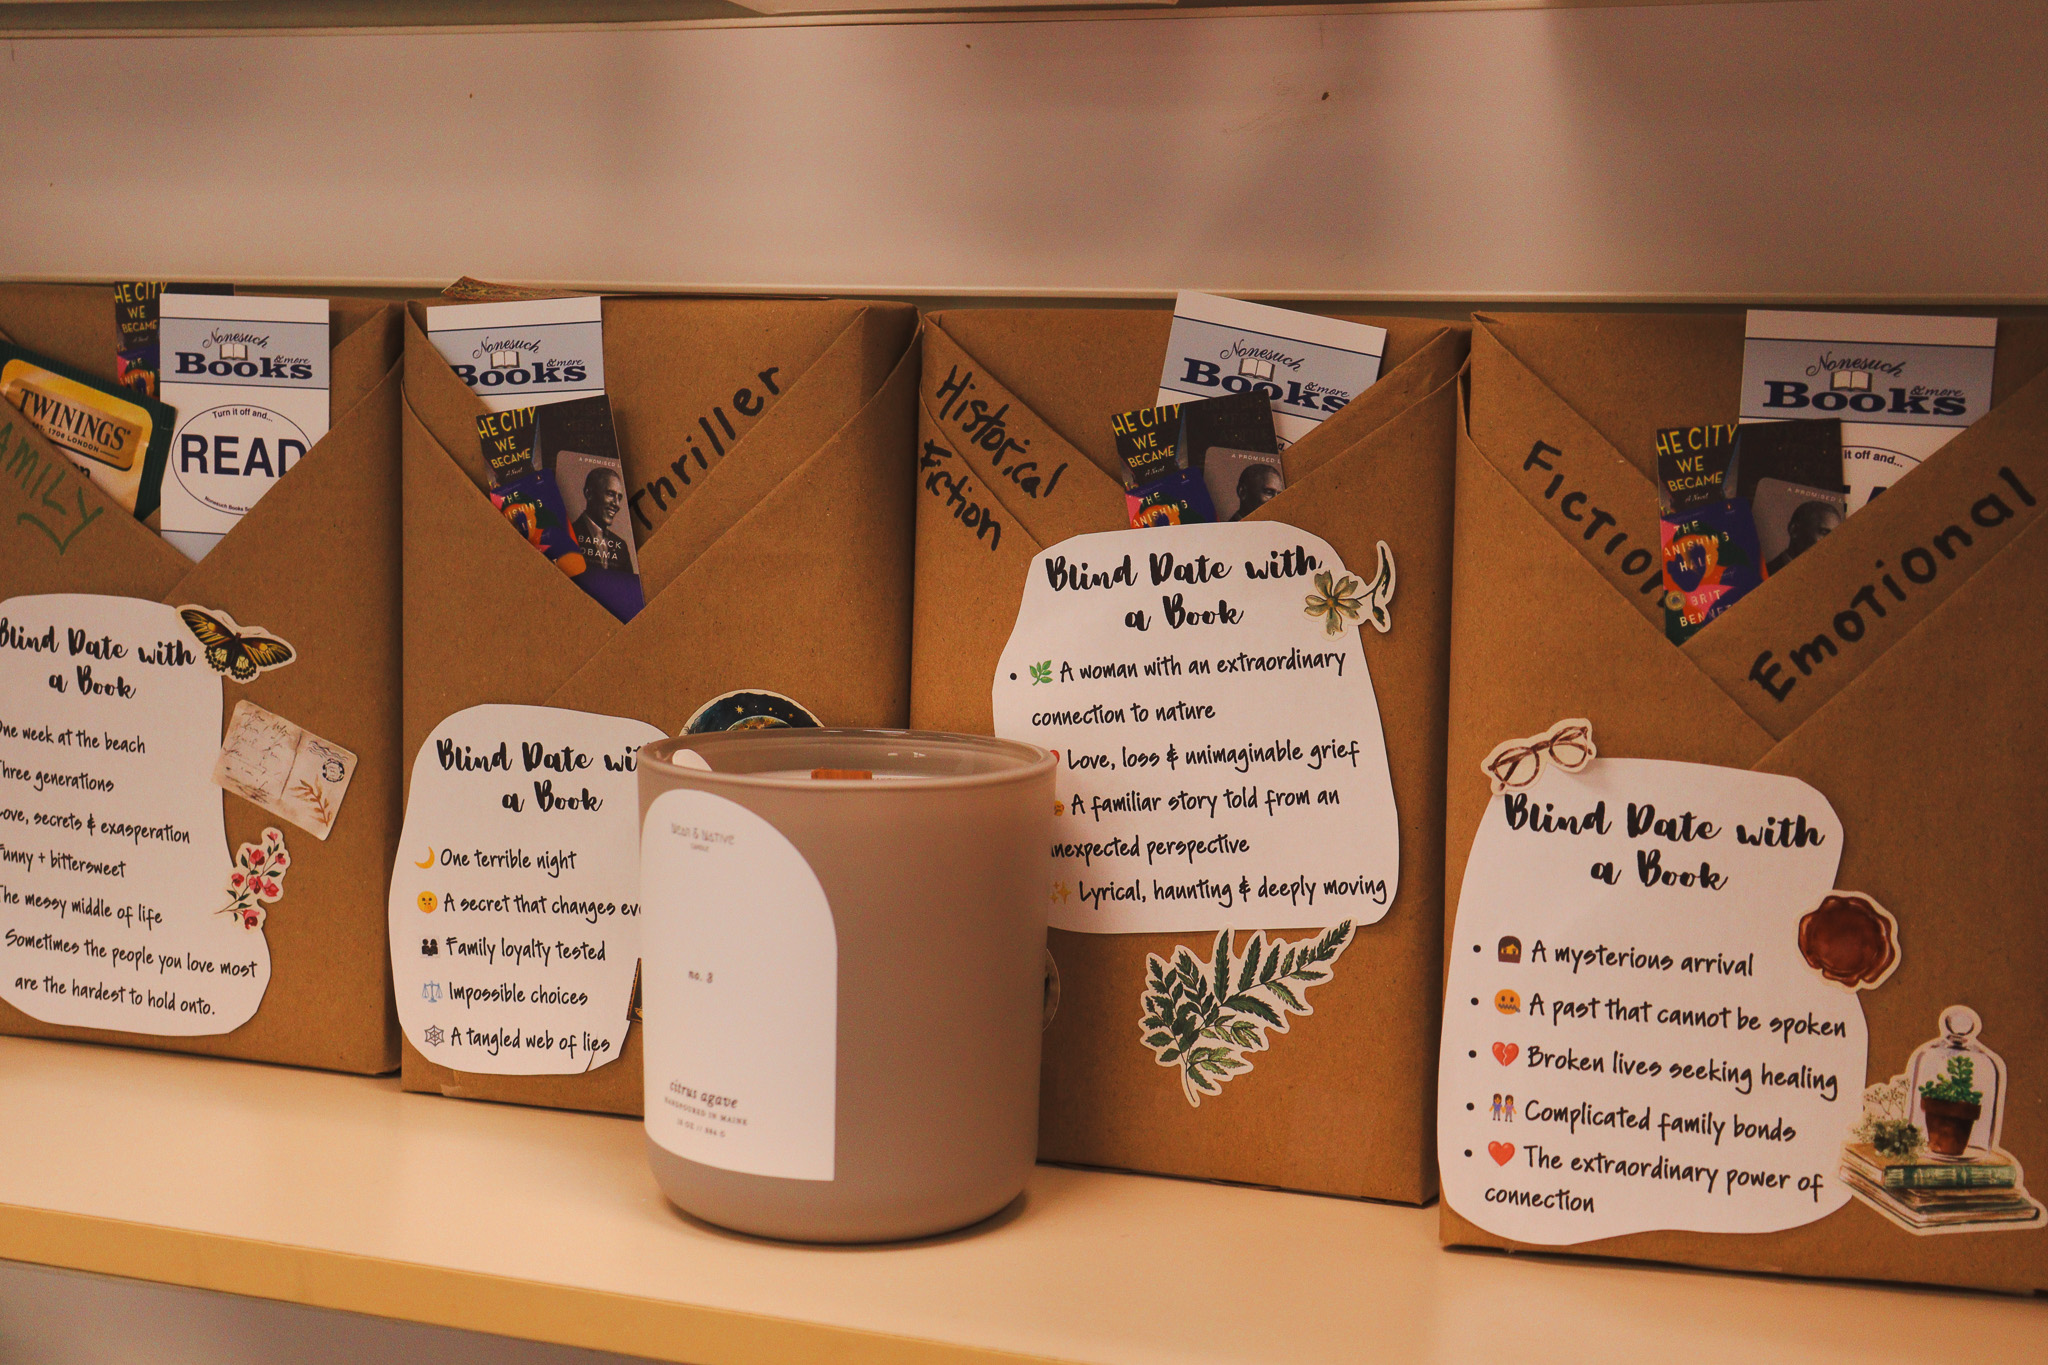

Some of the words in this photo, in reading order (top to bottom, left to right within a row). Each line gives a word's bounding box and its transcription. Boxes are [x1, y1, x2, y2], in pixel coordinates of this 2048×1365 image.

[127, 305, 145, 319] WE
[122, 320, 158, 334] BECAME
[202, 327, 268, 349] Nonesuch
[472, 336, 542, 359] Nonesuch
[1220, 339, 1303, 372] Nonesuch
[175, 352, 313, 380] Books
[453, 359, 588, 387] Books
[1805, 351, 1907, 379] Nonesuch
[1180, 356, 1352, 414] Books
[1762, 378, 1967, 417] Books
[212, 410, 231, 419] Turn
[232, 408, 238, 416] it
[240, 408, 251, 416] off
[500, 406, 537, 432] CITY
[1139, 403, 1181, 428] CITY
[67, 435, 99, 453] LONDON
[494, 436, 517, 452] WE
[936, 364, 1068, 499] Historical
[1132, 432, 1158, 450] WE
[1688, 424, 1738, 451] CITY
[181, 433, 308, 479] READ
[490, 448, 532, 469] BECAME
[584, 458, 616, 467] PROMISED
[1127, 444, 1175, 468] BECAME
[1238, 454, 1276, 464] PROMISED
[1676, 455, 1704, 474] WE
[1843, 449, 1852, 460] it
[1855, 450, 1871, 460] off
[920, 439, 1002, 551] Fiction
[1667, 471, 1724, 492] BECAME
[1794, 489, 1836, 502] PROMISED
[578, 535, 622, 550] BARACK
[1046, 555, 1138, 591] Blind
[1149, 552, 1232, 586] Date
[1245, 545, 1322, 579] with
[1125, 610, 1151, 631] a
[1162, 593, 1244, 629] Book
[0, 617, 59, 653] Blind
[68, 628, 128, 660] Date
[138, 640, 196, 666] with
[1060, 661, 1074, 682] A
[1080, 663, 1138, 679] woman
[1144, 655, 1181, 676] with
[1189, 660, 1210, 675] an
[1217, 647, 1346, 676] extraordinary
[49, 675, 68, 693] a
[77, 665, 136, 699] Book
[1032, 705, 1125, 726] connection
[1130, 703, 1148, 722] to
[1156, 701, 1215, 721] nature
[23, 726, 54, 743] week
[58, 729, 73, 745] at
[76, 730, 99, 748] the
[105, 732, 145, 753] beach
[437, 738, 512, 772] Blind
[522, 742, 593, 772] Date
[1068, 749, 1115, 770] Love,
[1122, 746, 1160, 767] loss
[1186, 739, 1303, 773] unimaginable
[1307, 739, 1360, 770] grief
[34, 771, 114, 792] generations
[502, 793, 525, 812] a
[534, 780, 603, 812] Book
[1071, 794, 1086, 815] A
[1091, 790, 1161, 822] familiar
[1168, 791, 1217, 818] story
[1223, 786, 1258, 808] told
[1265, 790, 1310, 816] from
[1318, 790, 1340, 805] an
[34, 813, 82, 830] secrets
[101, 823, 189, 845] exasperation
[1504, 793, 1612, 835] Blind
[1627, 803, 1722, 842] Date
[1736, 815, 1825, 848] with
[51, 850, 126, 877] bittersweet
[441, 849, 470, 866] One
[474, 849, 531, 868] terrible
[537, 850, 577, 878] night
[1147, 834, 1249, 865] perspective
[1591, 862, 1621, 885] a
[1637, 849, 1728, 890] Book
[1079, 879, 1146, 910] Lyrical,
[1153, 879, 1232, 908] haunting
[1258, 875, 1316, 906] deeply
[1323, 875, 1387, 905] moving
[25, 894, 66, 918] messy
[72, 897, 112, 917] middle
[117, 906, 133, 928] of
[139, 904, 162, 931] life
[444, 893, 455, 912] A
[460, 895, 510, 912] secret
[513, 894, 547, 913] that
[552, 895, 615, 924] changes
[5, 929, 79, 954] Sometimes
[84, 939, 107, 957] the
[112, 946, 153, 971] people
[159, 955, 181, 974] you
[188, 953, 214, 972] love
[220, 961, 257, 977] most
[446, 937, 496, 965] Family
[502, 937, 551, 967] loyalty
[555, 941, 605, 961] tested
[1532, 940, 1546, 962] A
[1555, 945, 1673, 974] mysterious
[1681, 953, 1753, 976] arrival
[15, 977, 38, 990] are
[43, 976, 66, 994] the
[72, 979, 126, 1003] hardest
[129, 988, 142, 1005] to
[148, 990, 175, 1010] hold
[181, 998, 214, 1014] onto.
[449, 982, 525, 1009] Impossible
[531, 985, 588, 1005] choices
[1530, 993, 1544, 1016] A
[1553, 998, 1600, 1026] past
[1605, 998, 1652, 1022] that
[1657, 1007, 1731, 1028] cannot
[1738, 1007, 1761, 1030] be
[1770, 1012, 1846, 1044] spoken
[451, 1027, 462, 1046] A
[466, 1027, 520, 1056] tangled
[526, 1030, 553, 1049] web
[559, 1035, 577, 1059] of
[583, 1031, 610, 1052] lies
[1528, 1046, 1604, 1073] Broken
[1613, 1051, 1662, 1077] lives
[1669, 1058, 1752, 1095] seeking
[1762, 1063, 1837, 1101] healing
[669, 1080, 697, 1099] citrus
[700, 1092, 738, 1109] agave
[1525, 1100, 1650, 1134] Complicated
[1658, 1112, 1725, 1146] family
[1734, 1114, 1796, 1142] bonds
[1523, 1145, 1562, 1169] The
[1571, 1153, 1718, 1193] extraordinary
[1727, 1169, 1790, 1195] power
[1798, 1174, 1823, 1202] of
[1485, 1188, 1594, 1213] connection
